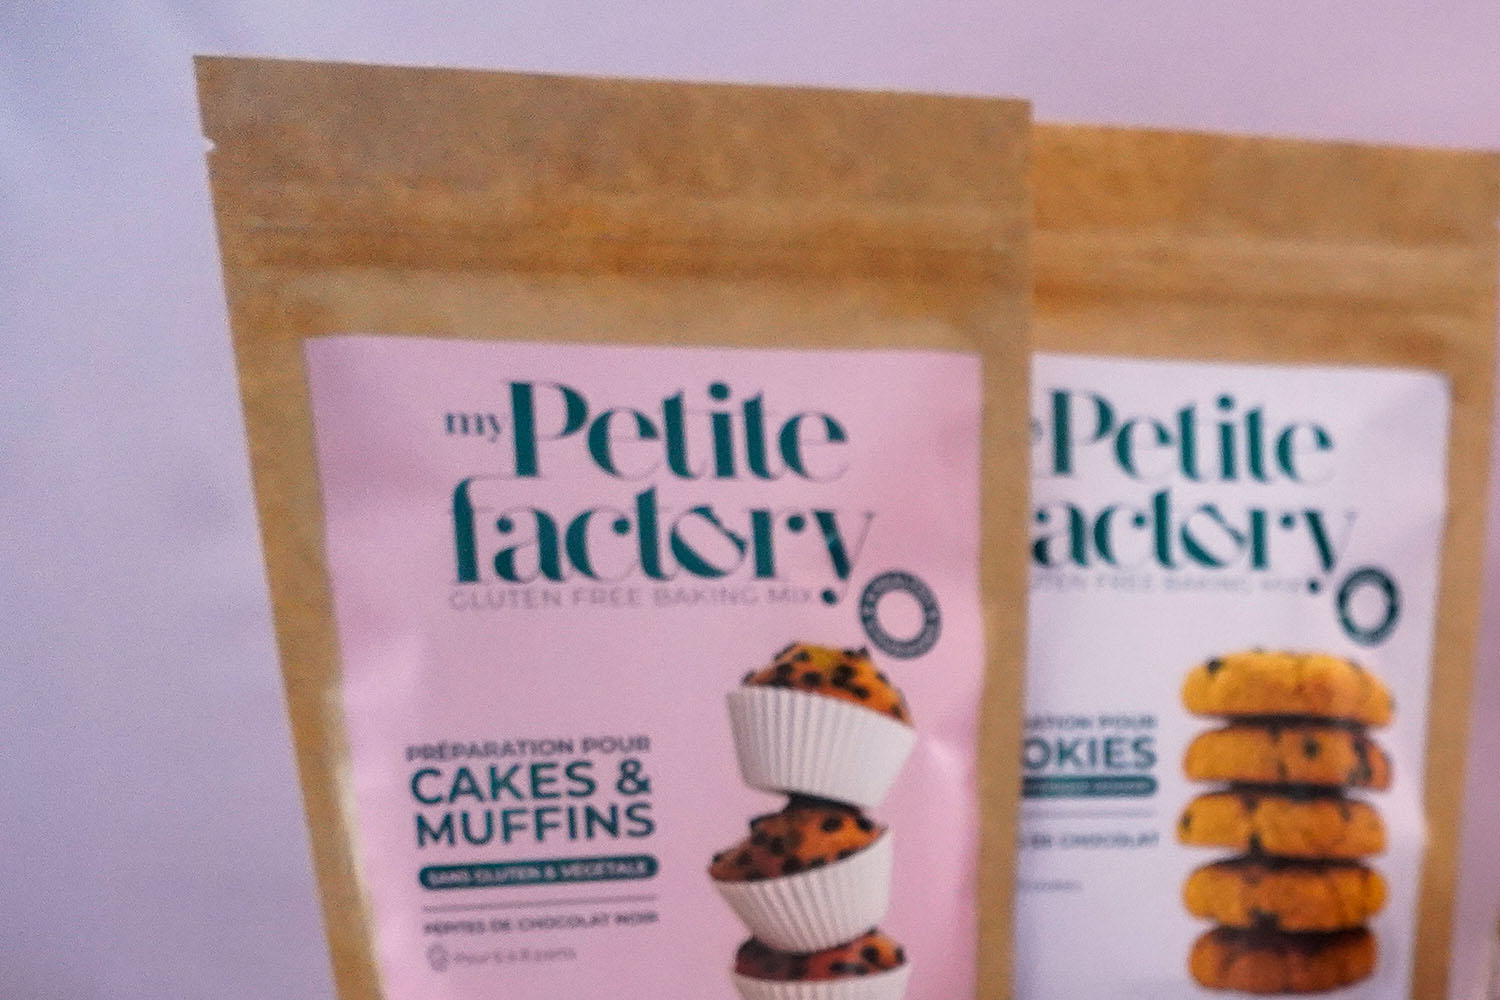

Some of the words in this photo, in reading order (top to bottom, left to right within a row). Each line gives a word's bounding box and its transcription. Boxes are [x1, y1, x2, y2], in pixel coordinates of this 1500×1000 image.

[445, 410, 502, 442] my
[504, 380, 850, 481] Petite
[1047, 388, 1336, 484] Petite
[448, 475, 876, 605] factory
[1030, 489, 1358, 594] actory
[449, 585, 561, 611] GLUTEN
[572, 584, 640, 608] FREE
[654, 583, 759, 607] BAKING
[406, 738, 574, 761] PRÉPARATION
[582, 736, 650, 754] POUR
[1022, 735, 1158, 770] OKIES
[410, 761, 597, 806] CAKES
[616, 759, 651, 796] &
[415, 802, 655, 847] MUFFINS
